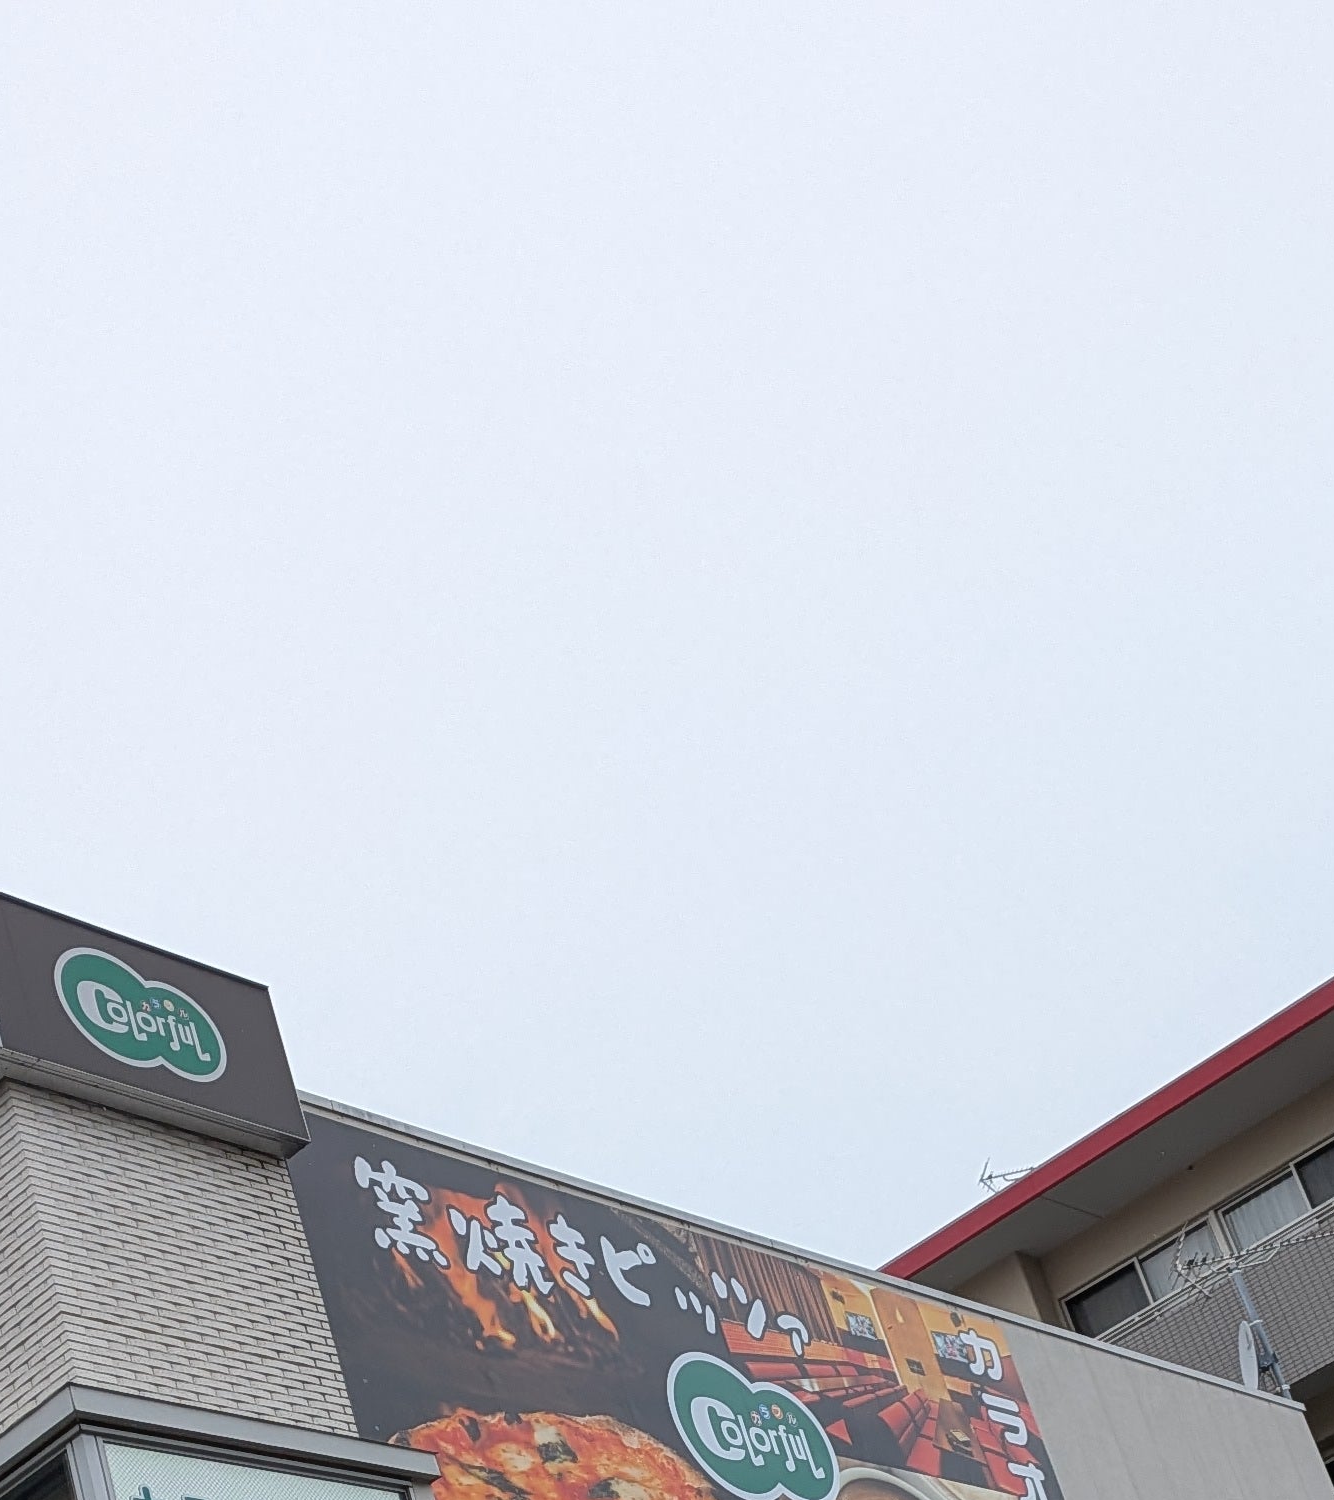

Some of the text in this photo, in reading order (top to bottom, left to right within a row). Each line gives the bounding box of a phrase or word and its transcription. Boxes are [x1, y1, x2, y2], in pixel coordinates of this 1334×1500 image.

[77, 980, 211, 1061] Colorful
[354, 1155, 810, 1358] 窯焼きピッツァ
[691, 1397, 825, 1479] Colorful
